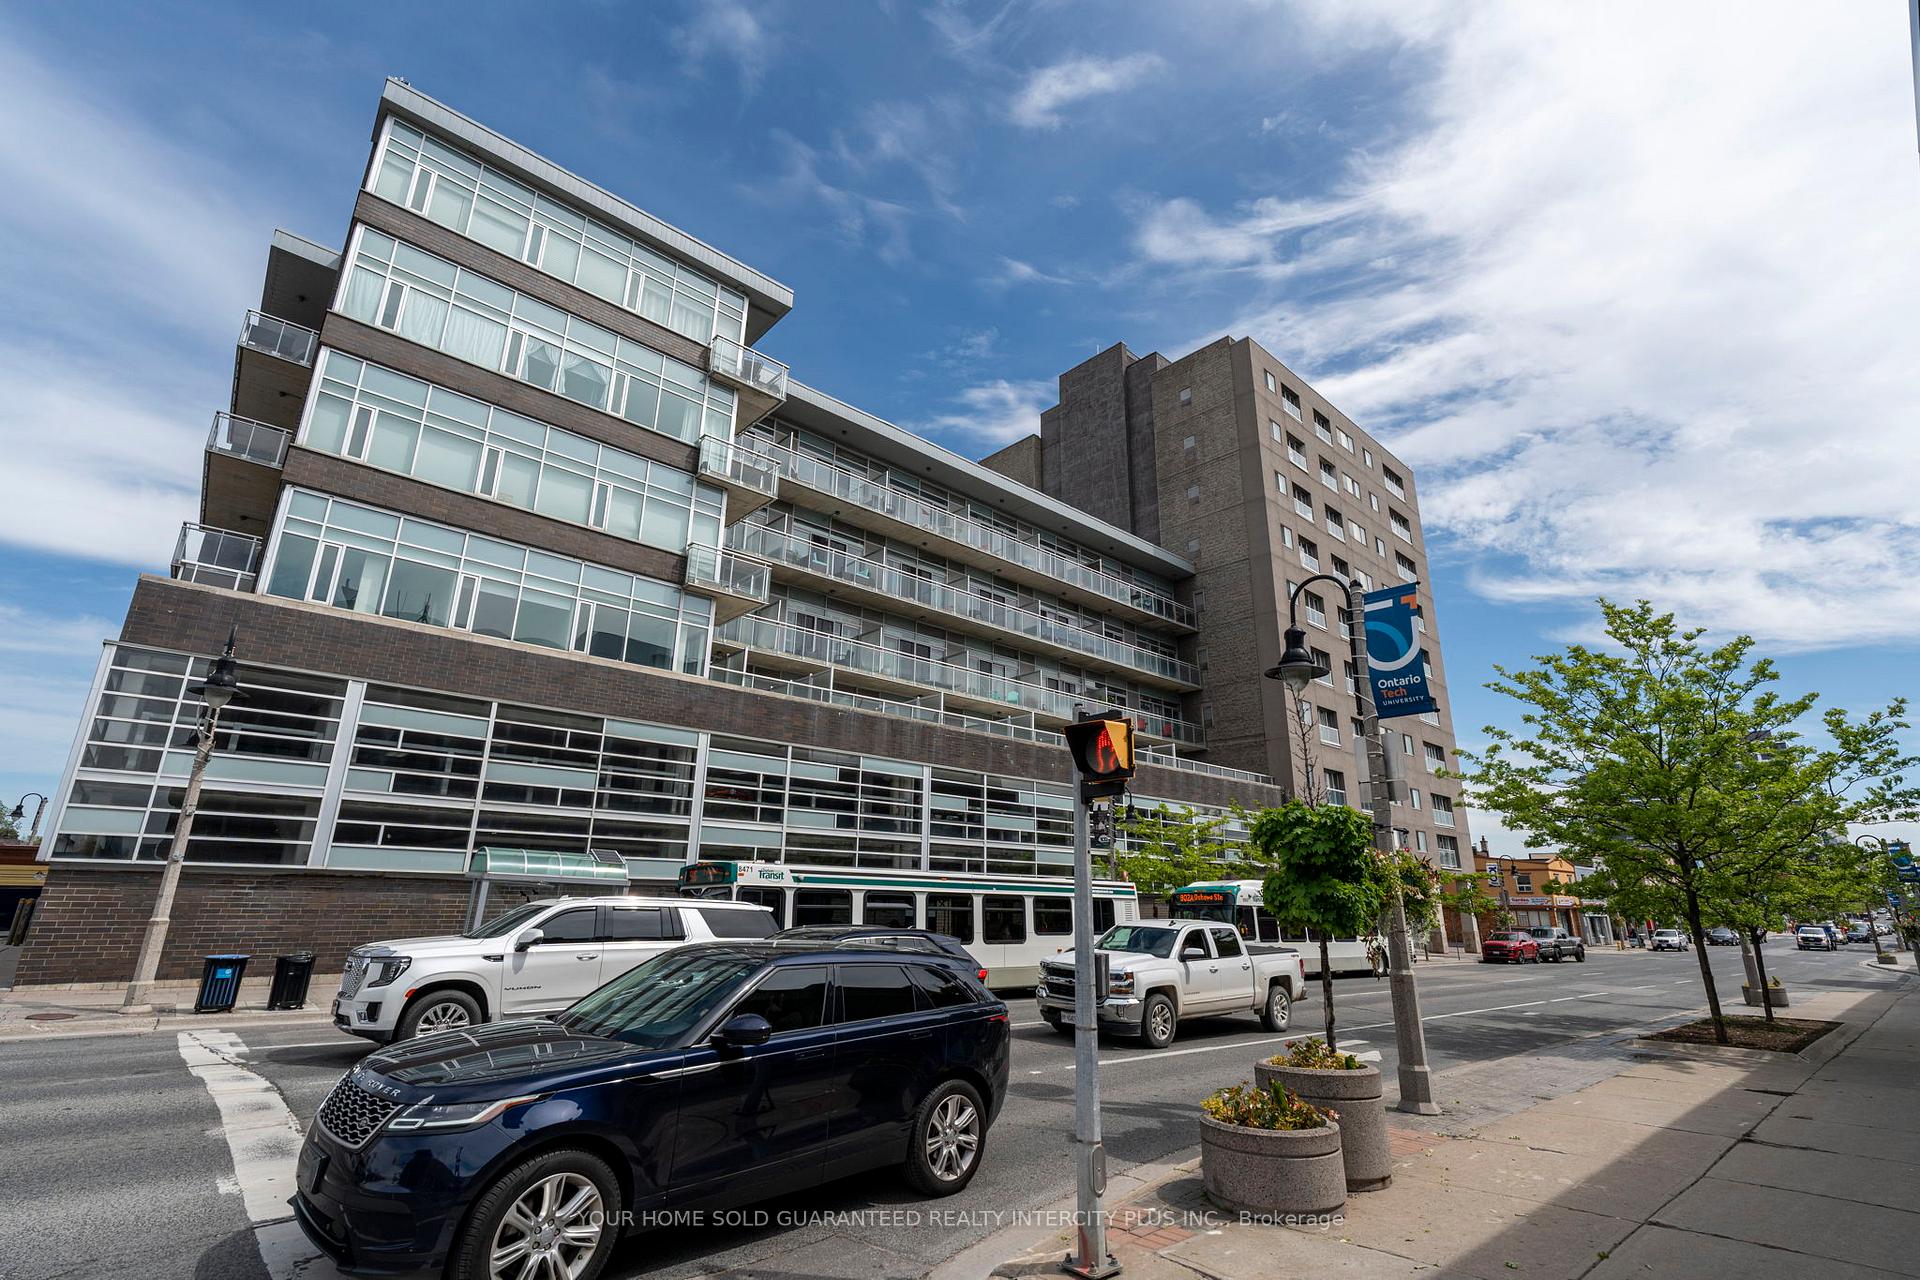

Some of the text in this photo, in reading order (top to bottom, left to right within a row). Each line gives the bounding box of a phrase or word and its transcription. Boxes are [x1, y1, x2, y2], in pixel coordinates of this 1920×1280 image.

[1378, 674, 1420, 688] Ontario
[1380, 687, 1407, 698] Tech
[1382, 696, 1424, 706] UNIVERSITY
[738, 865, 753, 873] 8471
[758, 870, 785, 880] Transit
[367, 1078, 401, 1097] ROVER
